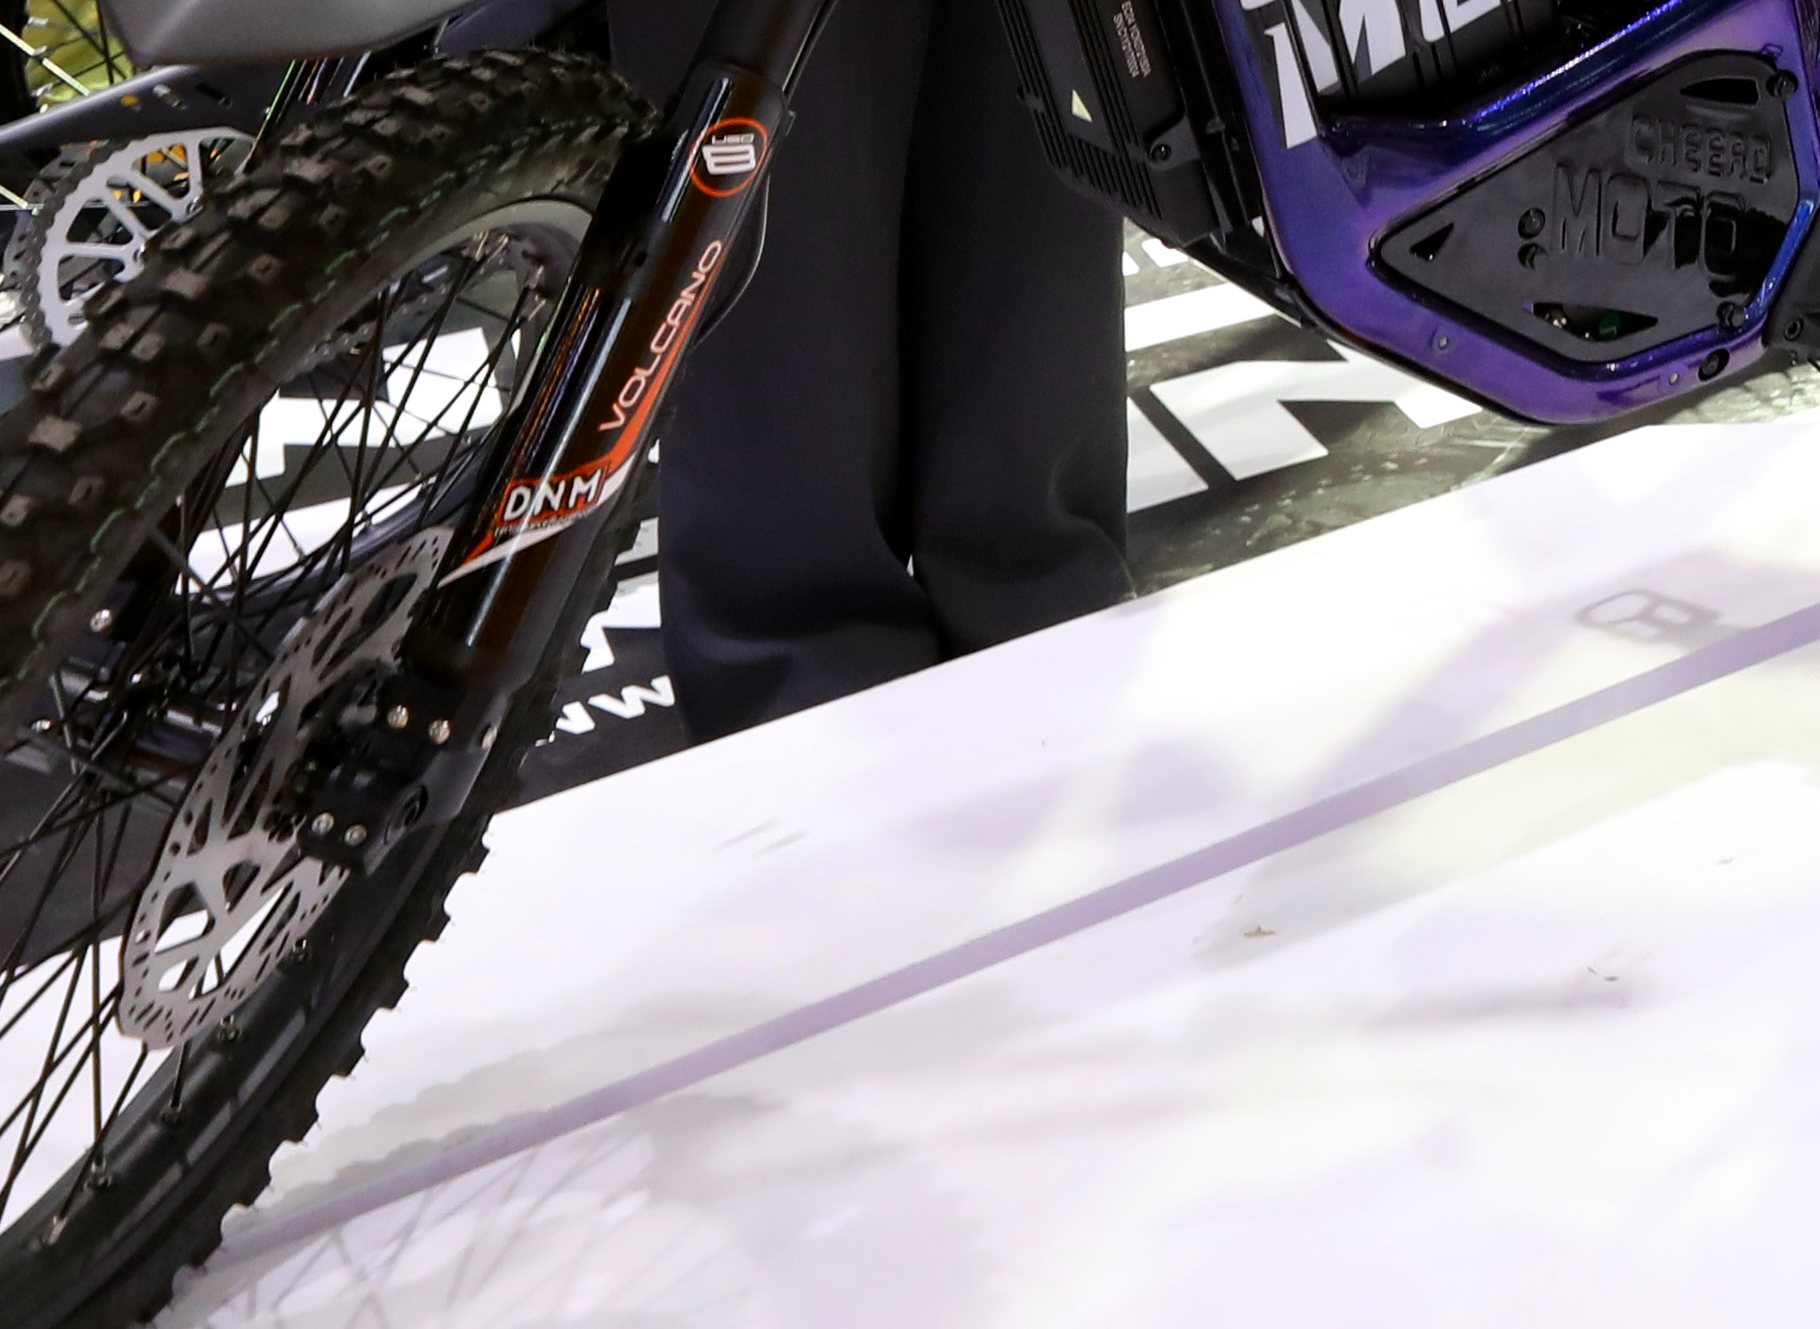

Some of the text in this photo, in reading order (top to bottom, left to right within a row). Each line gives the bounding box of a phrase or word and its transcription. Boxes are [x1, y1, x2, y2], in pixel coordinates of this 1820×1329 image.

[1553, 160, 1748, 280] MOTO
[597, 240, 722, 433] VOLCANO
[503, 468, 603, 522] DNM
